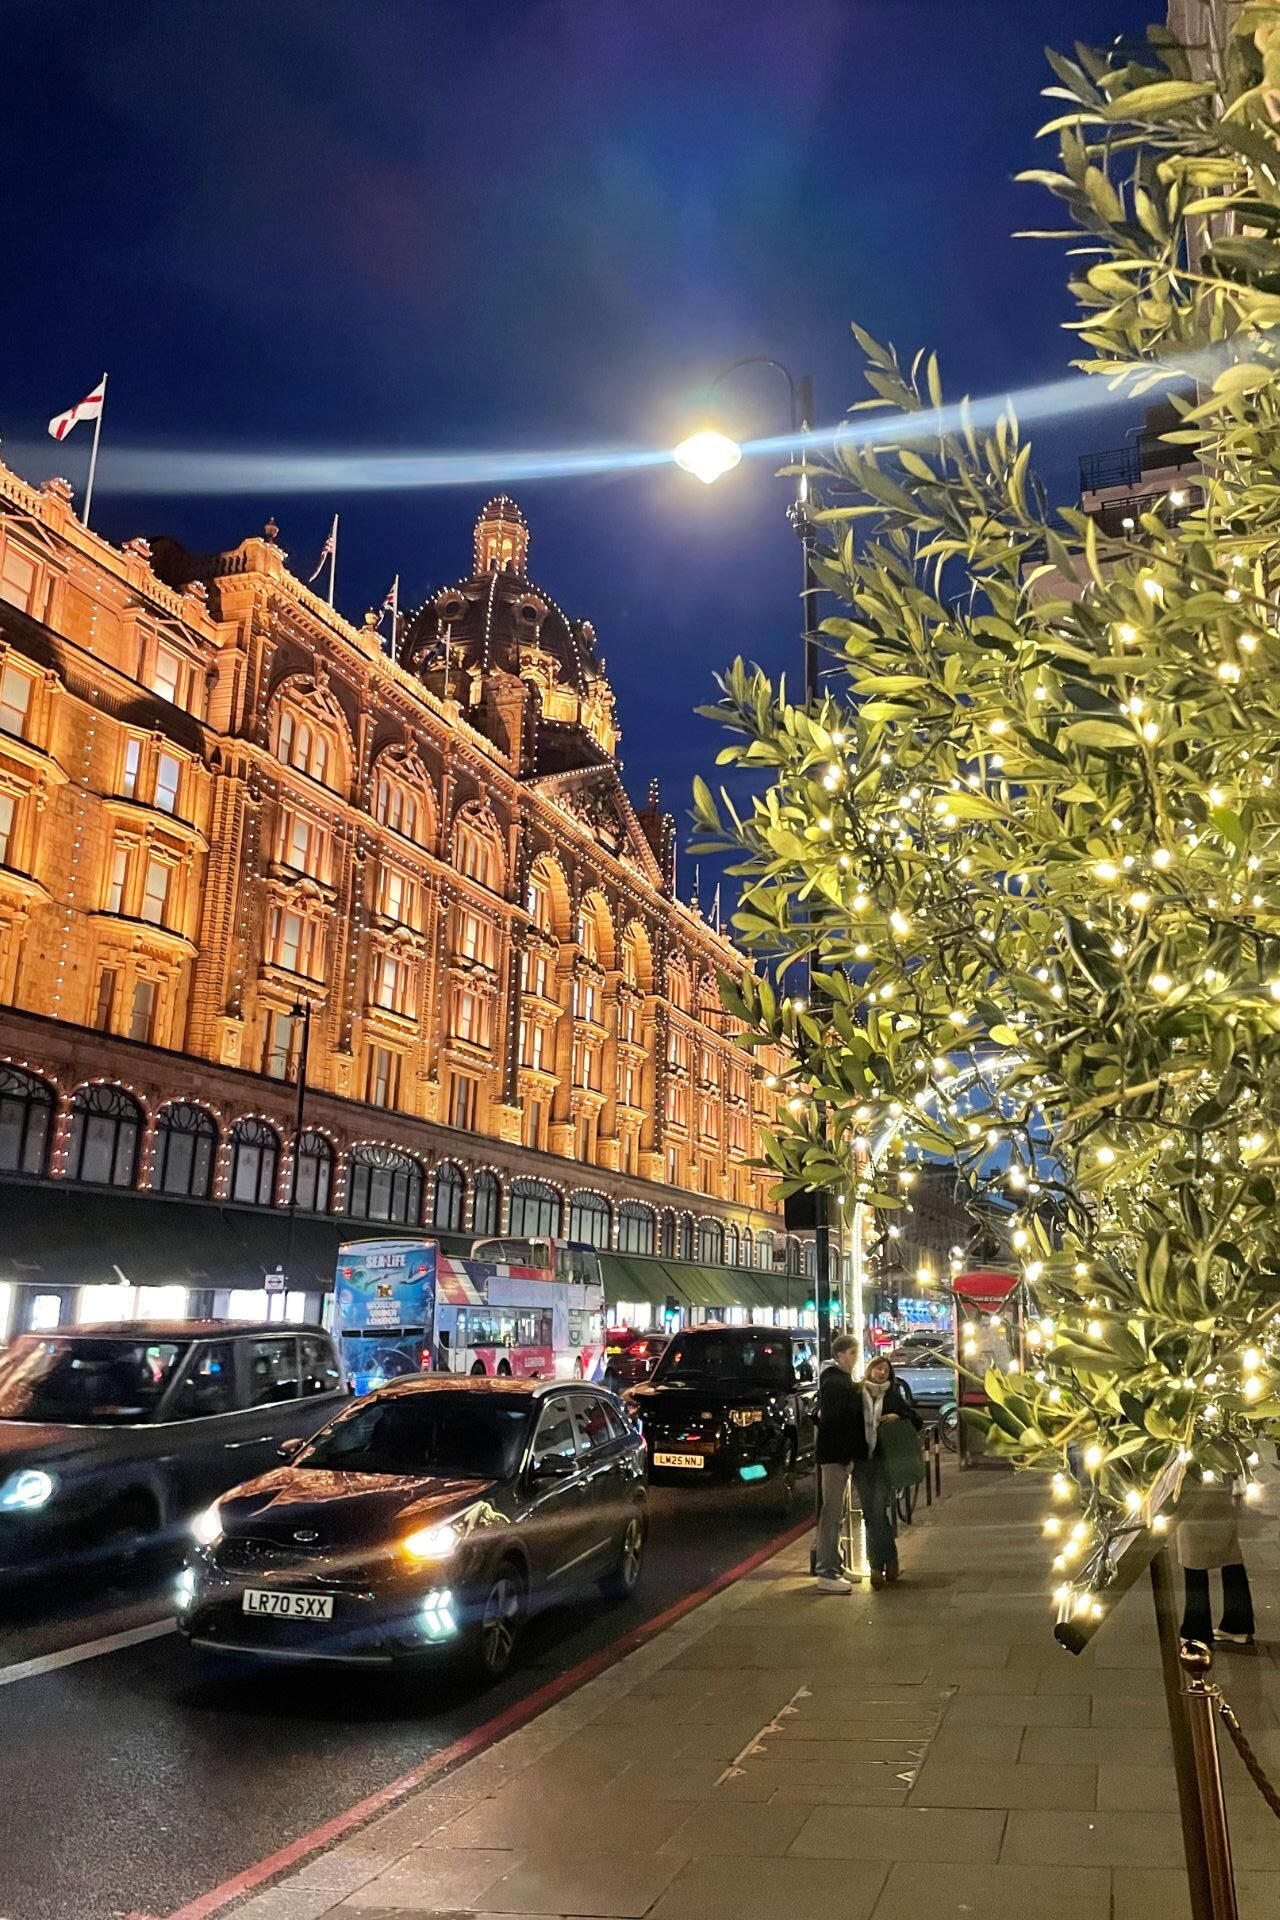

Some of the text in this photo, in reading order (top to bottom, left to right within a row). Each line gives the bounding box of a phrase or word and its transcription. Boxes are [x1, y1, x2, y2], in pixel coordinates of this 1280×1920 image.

[366, 1256, 385, 1268] SEA
[366, 1317, 400, 1325] LONDON
[524, 1356, 545, 1367] LONDON
[659, 1455, 683, 1465] LM25
[248, 1593, 327, 1616] LR70 SXX
